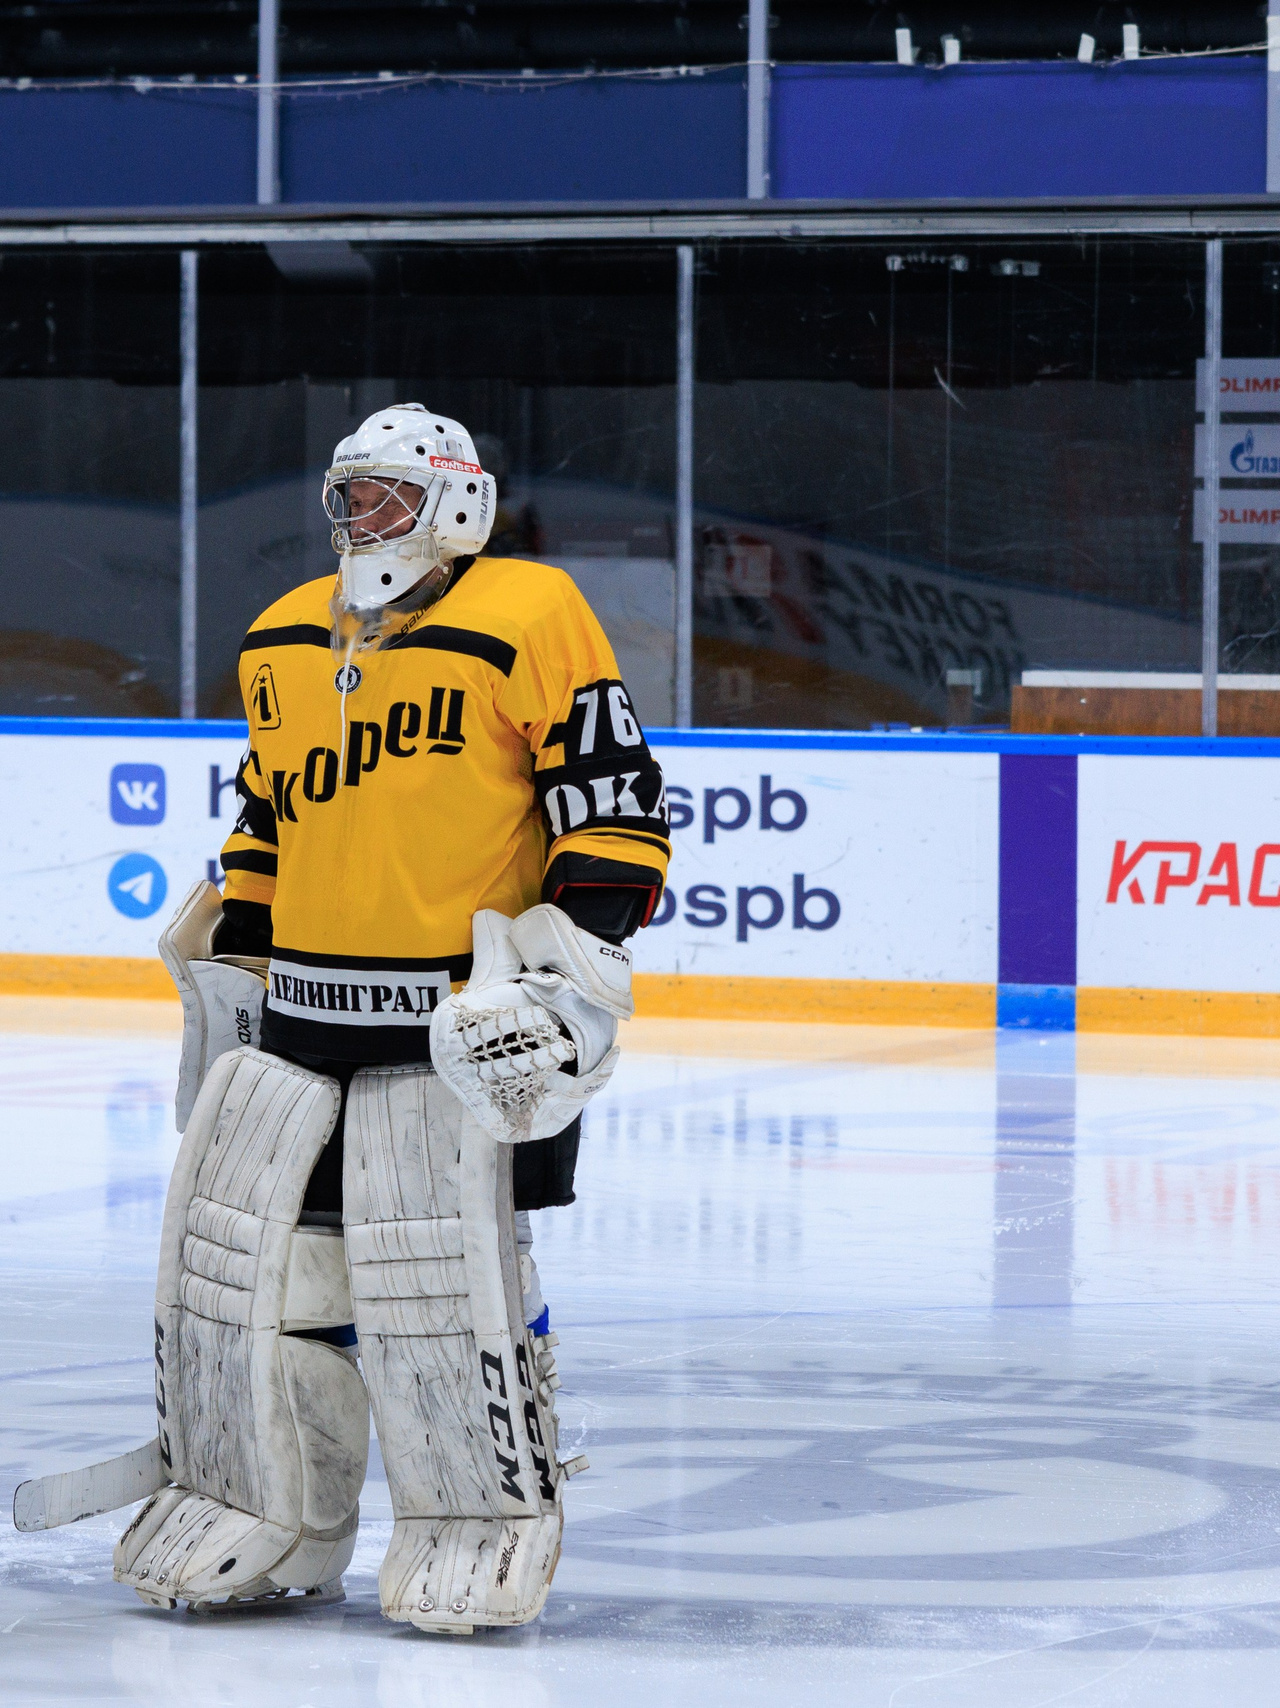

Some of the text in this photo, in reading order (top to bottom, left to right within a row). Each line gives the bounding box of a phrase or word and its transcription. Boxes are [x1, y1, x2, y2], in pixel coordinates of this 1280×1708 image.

[433, 458, 478, 473] FONBET
[1255, 457, 1280, 474] ГАЗ
[575, 686, 642, 755] 76
[599, 946, 629, 966] CCM
[270, 971, 439, 1019] ЛЕНИНГРАД
[480, 1349, 527, 1503] CCM
[516, 1342, 556, 1501] CCM
